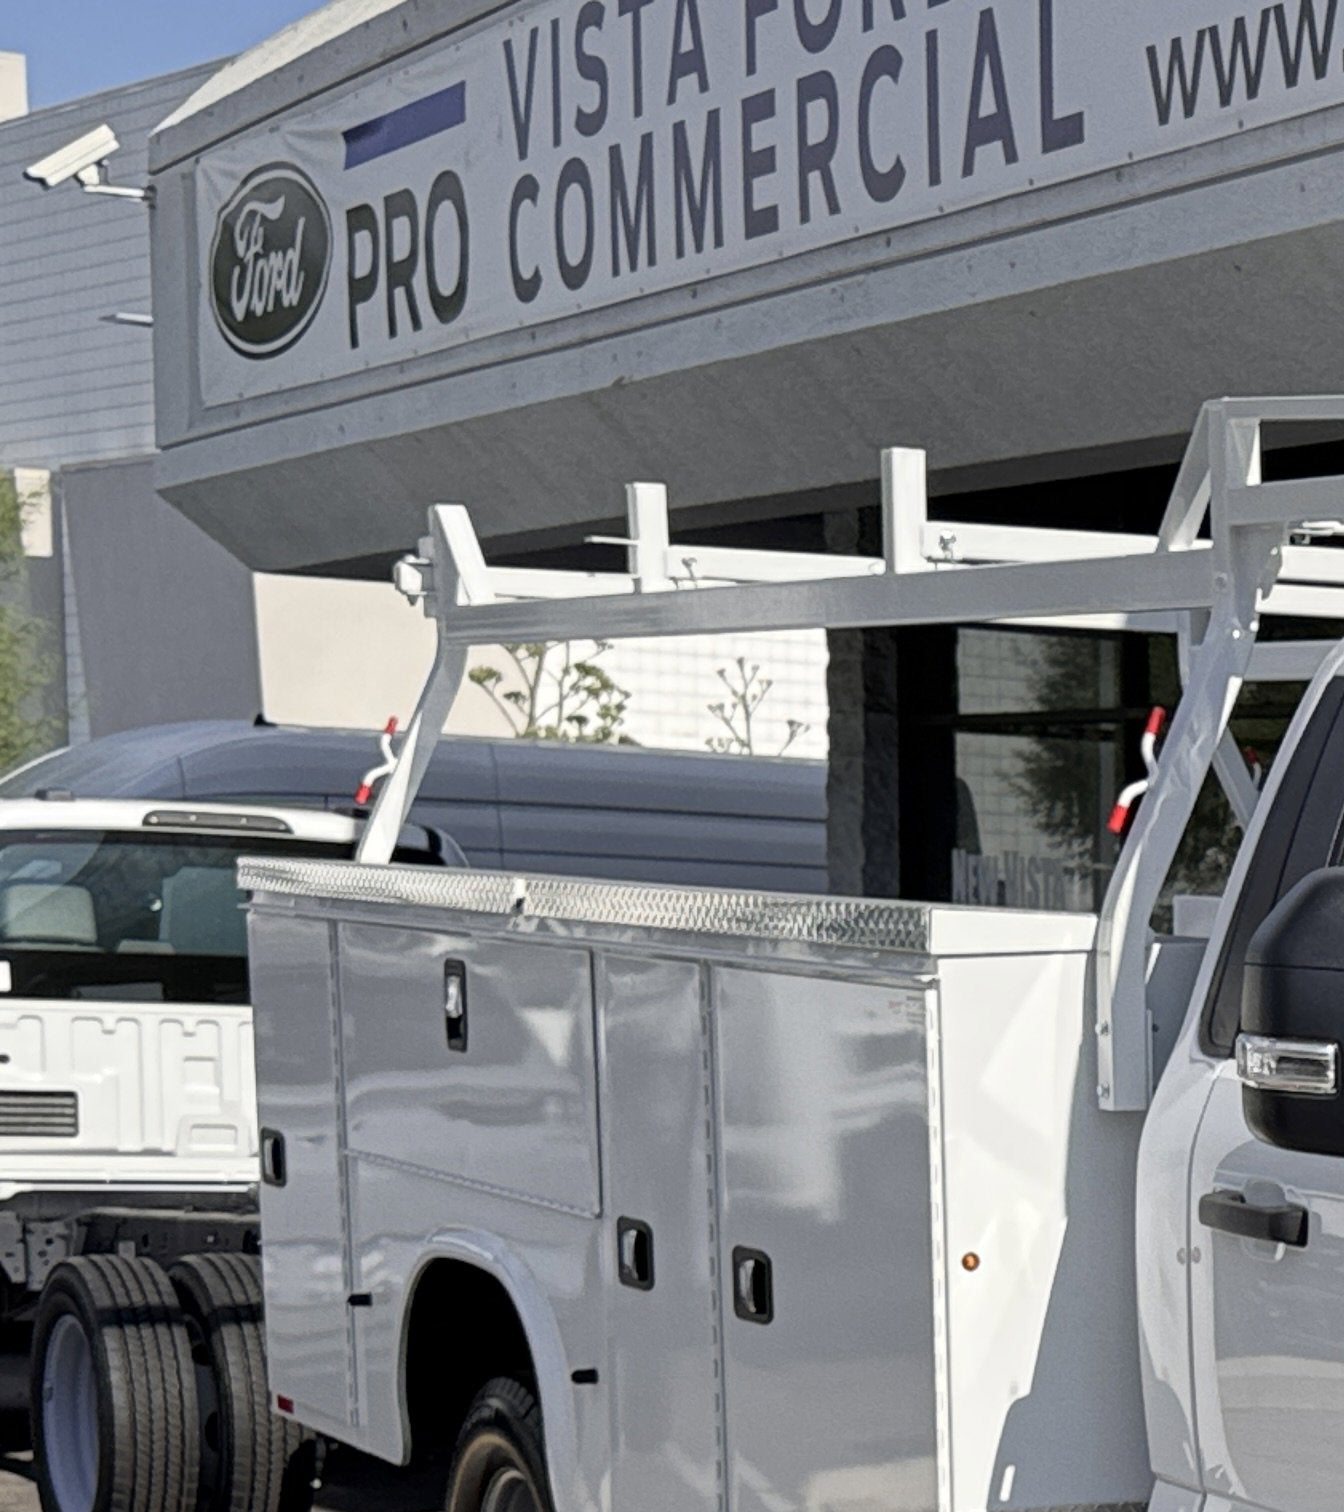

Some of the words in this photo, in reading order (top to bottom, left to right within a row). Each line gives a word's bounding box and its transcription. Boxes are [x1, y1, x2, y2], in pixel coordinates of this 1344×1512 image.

[502, 0, 710, 162] VISTA
[508, 0, 1086, 304] COMMERCIAL
[231, 195, 306, 322] Ford
[346, 169, 470, 350] PRO
